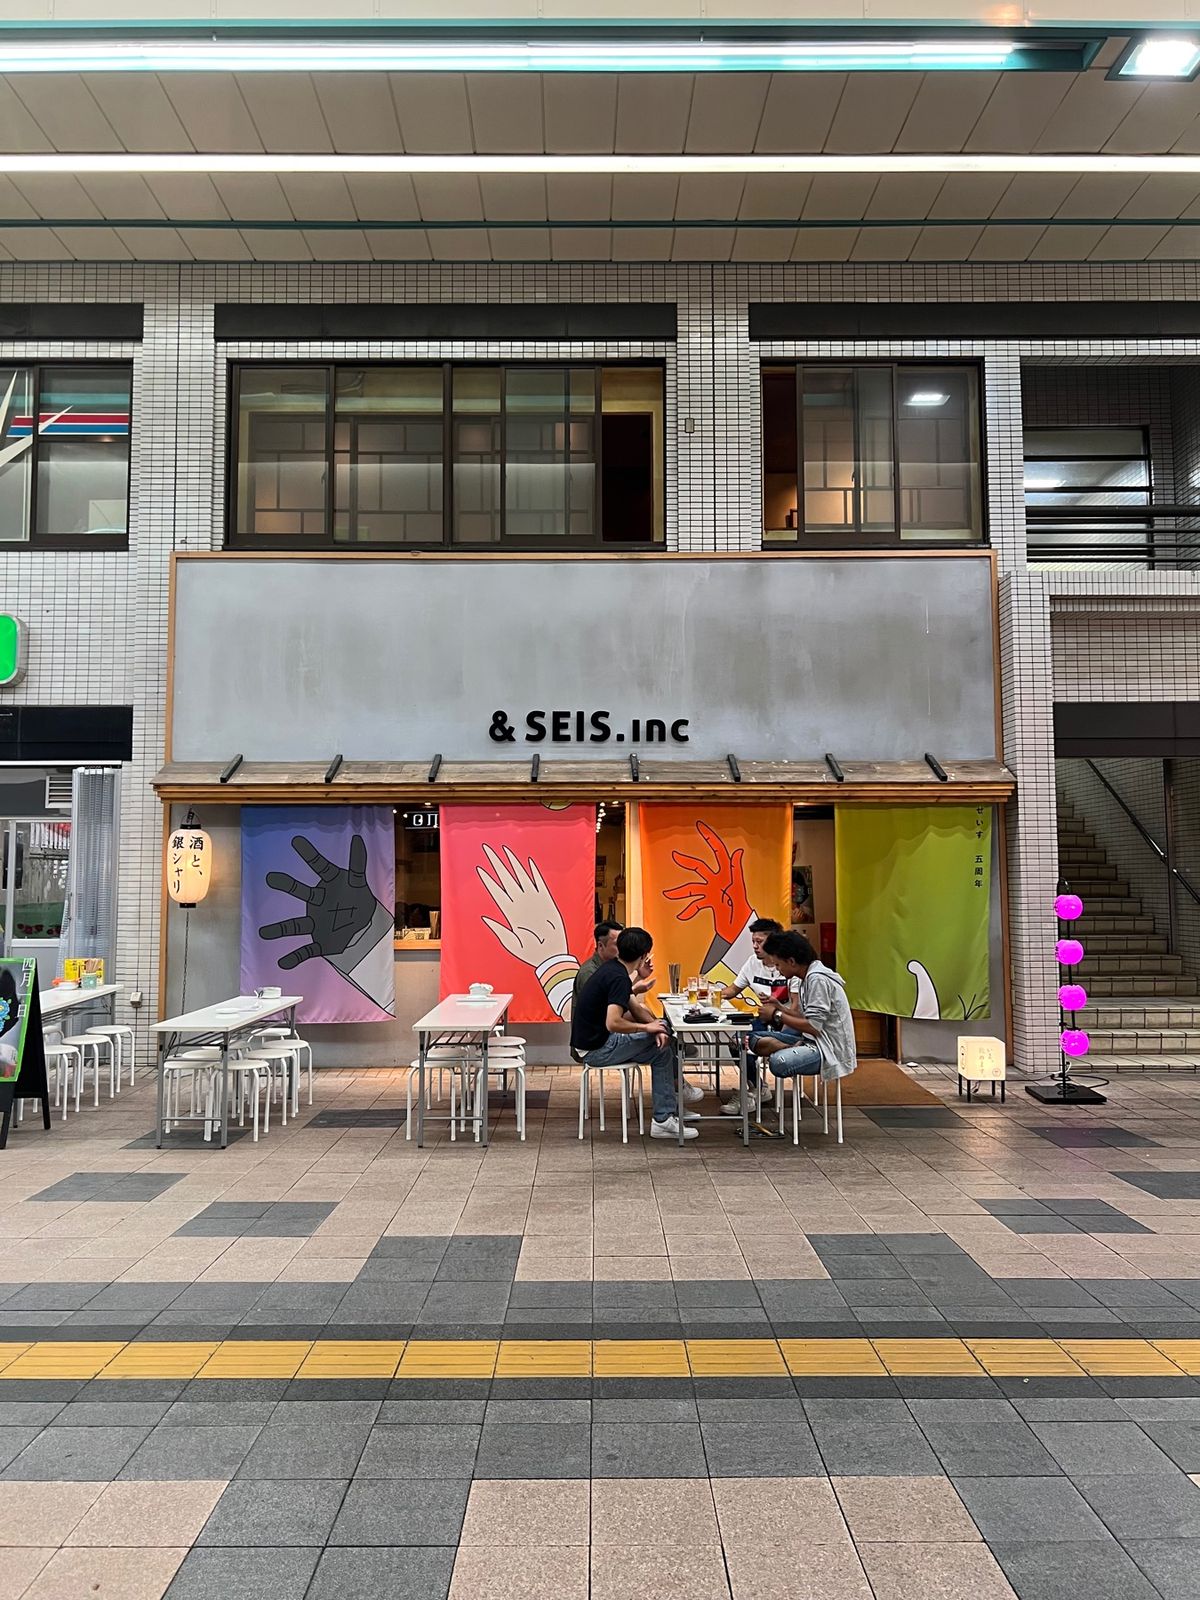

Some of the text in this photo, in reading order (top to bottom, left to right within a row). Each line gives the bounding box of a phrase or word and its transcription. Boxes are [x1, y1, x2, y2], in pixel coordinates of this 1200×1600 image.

[489, 710, 516, 742] &
[172, 835, 184, 894] 銀シャリ
[189, 835, 204, 876] 酒と、
[975, 855, 983, 887] 五周年
